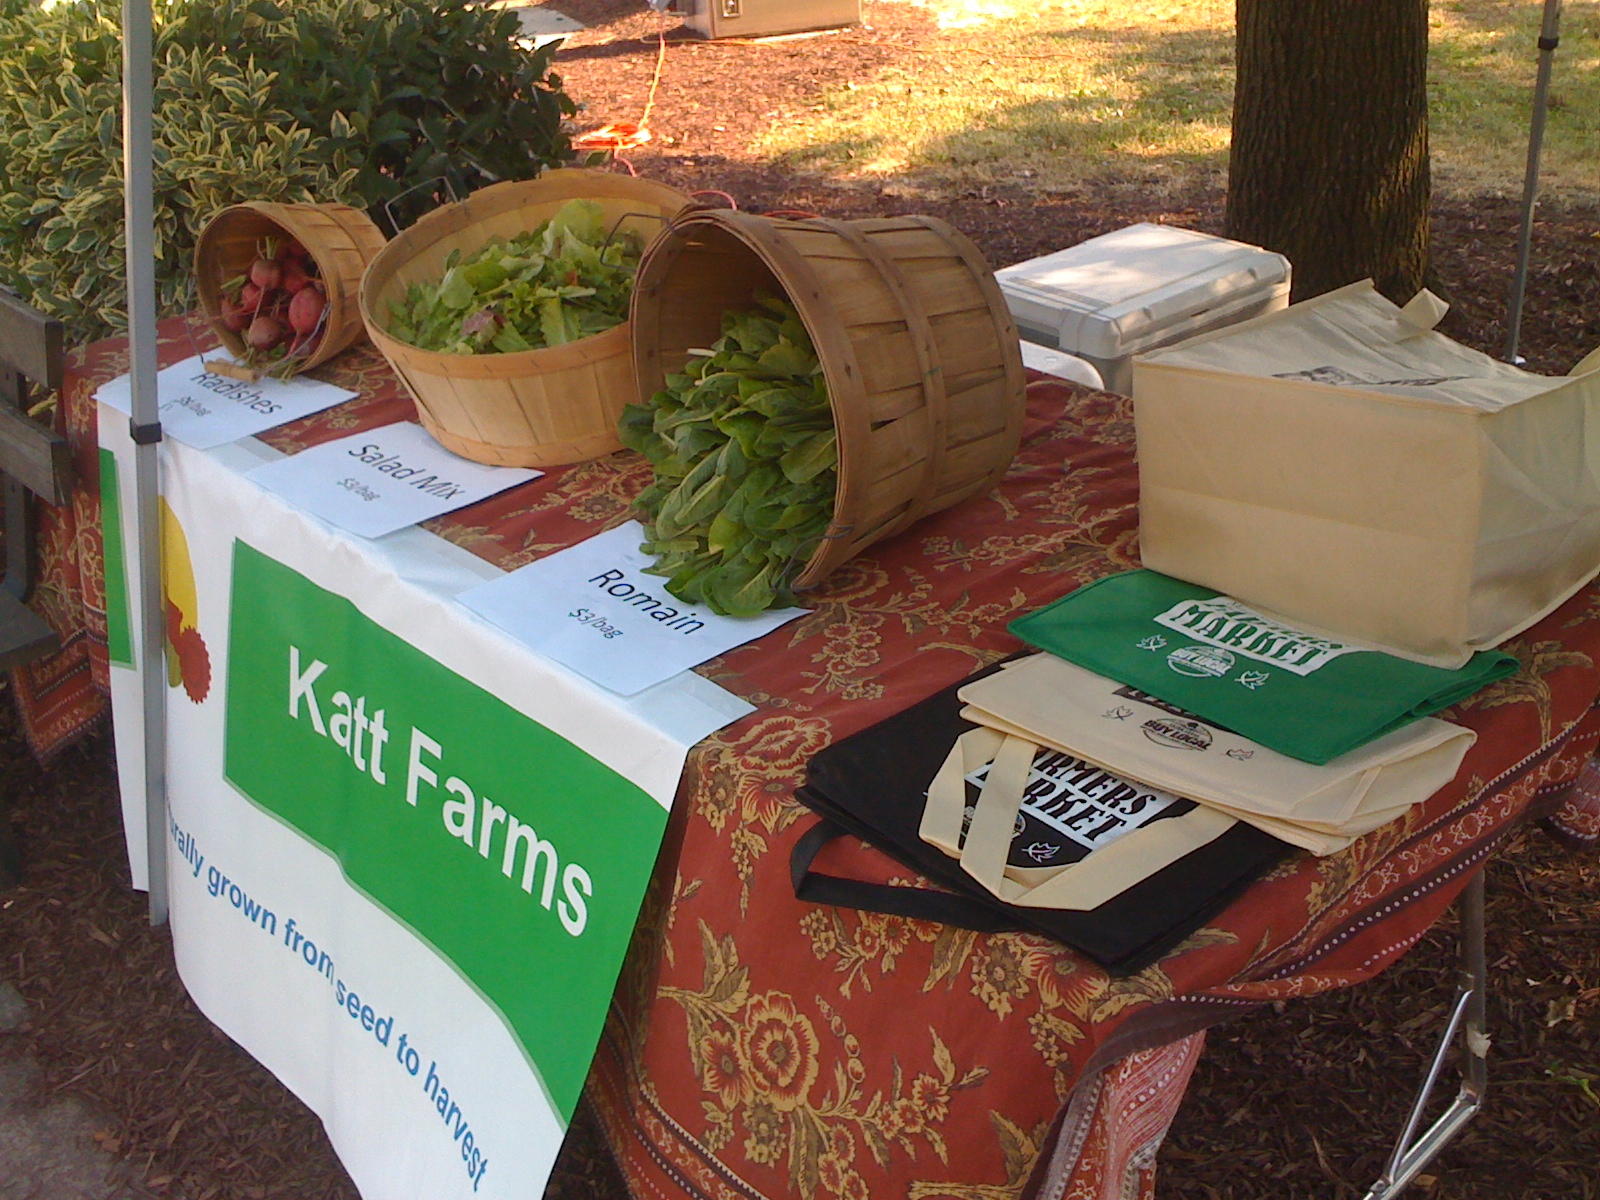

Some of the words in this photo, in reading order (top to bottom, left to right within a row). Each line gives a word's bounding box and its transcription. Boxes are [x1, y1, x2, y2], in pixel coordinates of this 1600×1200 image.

[191, 371, 282, 415] Radishes
[348, 444, 426, 480] Salad
[409, 475, 465, 500] Mix
[568, 607, 624, 640] $3/bag
[588, 568, 705, 635] Romain
[1169, 604, 1328, 666] MARKET
[1144, 719, 1174, 734] BUY
[1169, 730, 1212, 750] LOCAL
[289, 644, 390, 786] Katt
[405, 725, 593, 938] Farms
[1031, 750, 1157, 815] RMERS
[207, 865, 278, 935] grown
[284, 918, 334, 986] from
[335, 979, 394, 1048] seed
[396, 1033, 430, 1077] to
[423, 1060, 489, 1193] harvest
